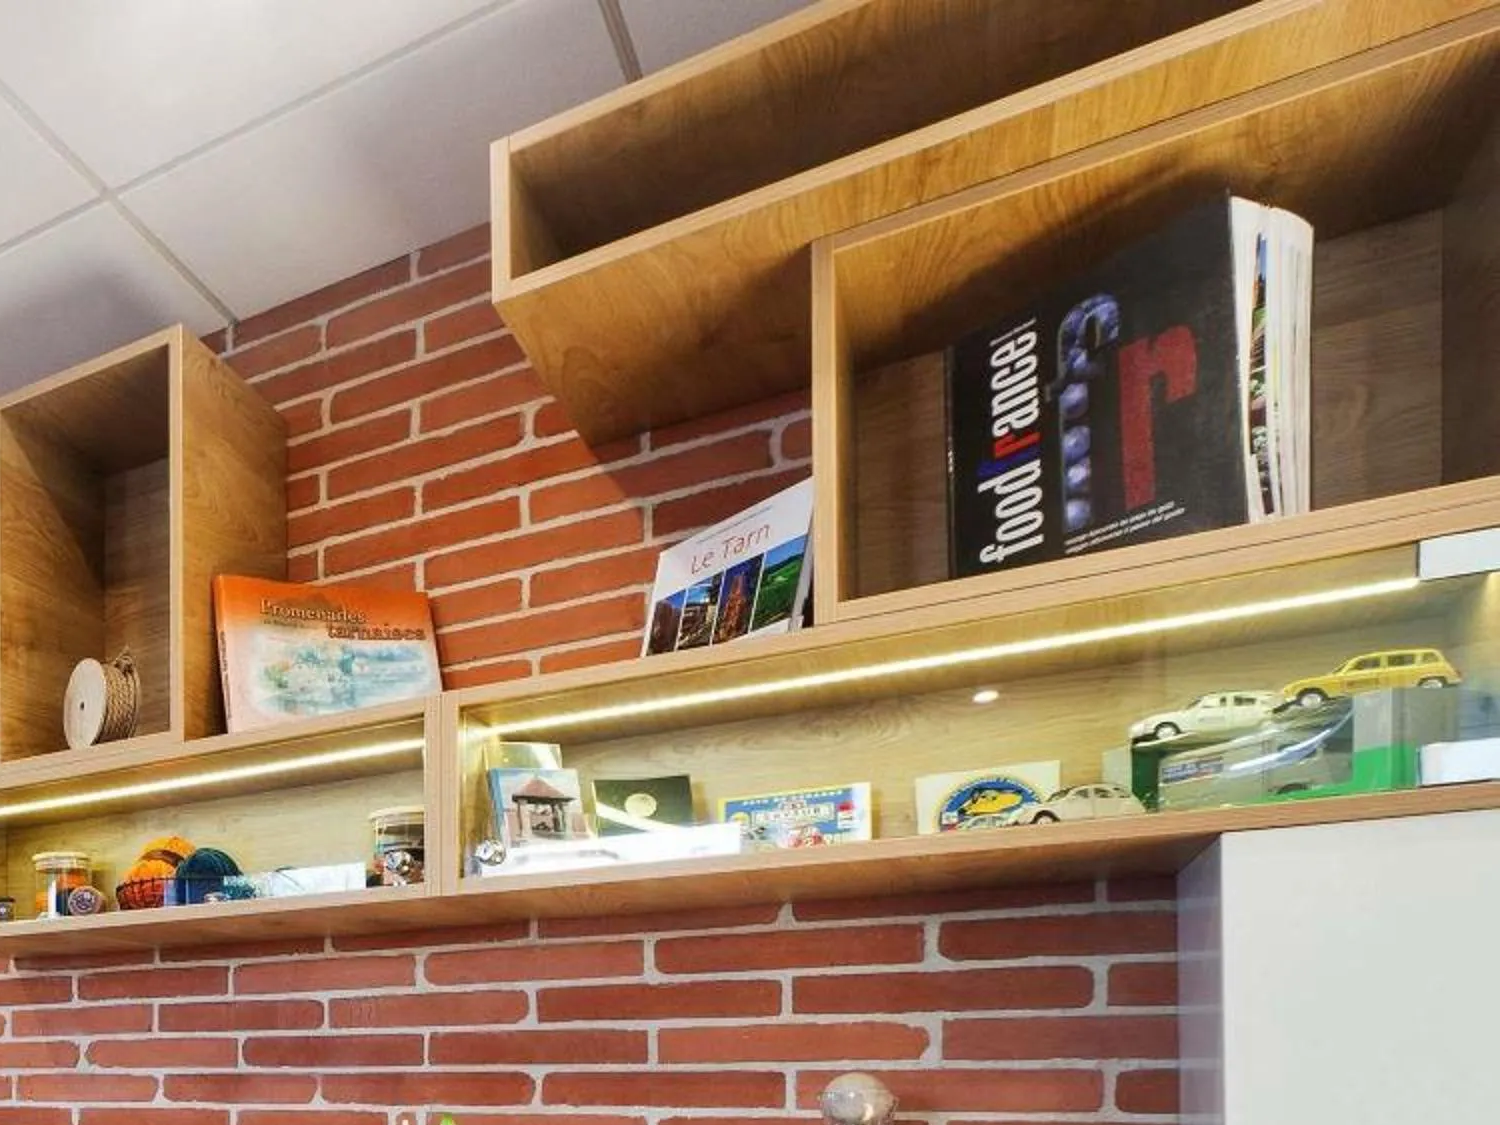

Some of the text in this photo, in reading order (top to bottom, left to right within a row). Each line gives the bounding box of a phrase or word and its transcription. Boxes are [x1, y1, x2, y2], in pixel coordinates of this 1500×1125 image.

[978, 459, 1045, 563] food
[690, 551, 716, 575] Le
[721, 524, 771, 558] Tarn
[259, 598, 367, 624] Promenades
[327, 622, 426, 641] tarnaises
